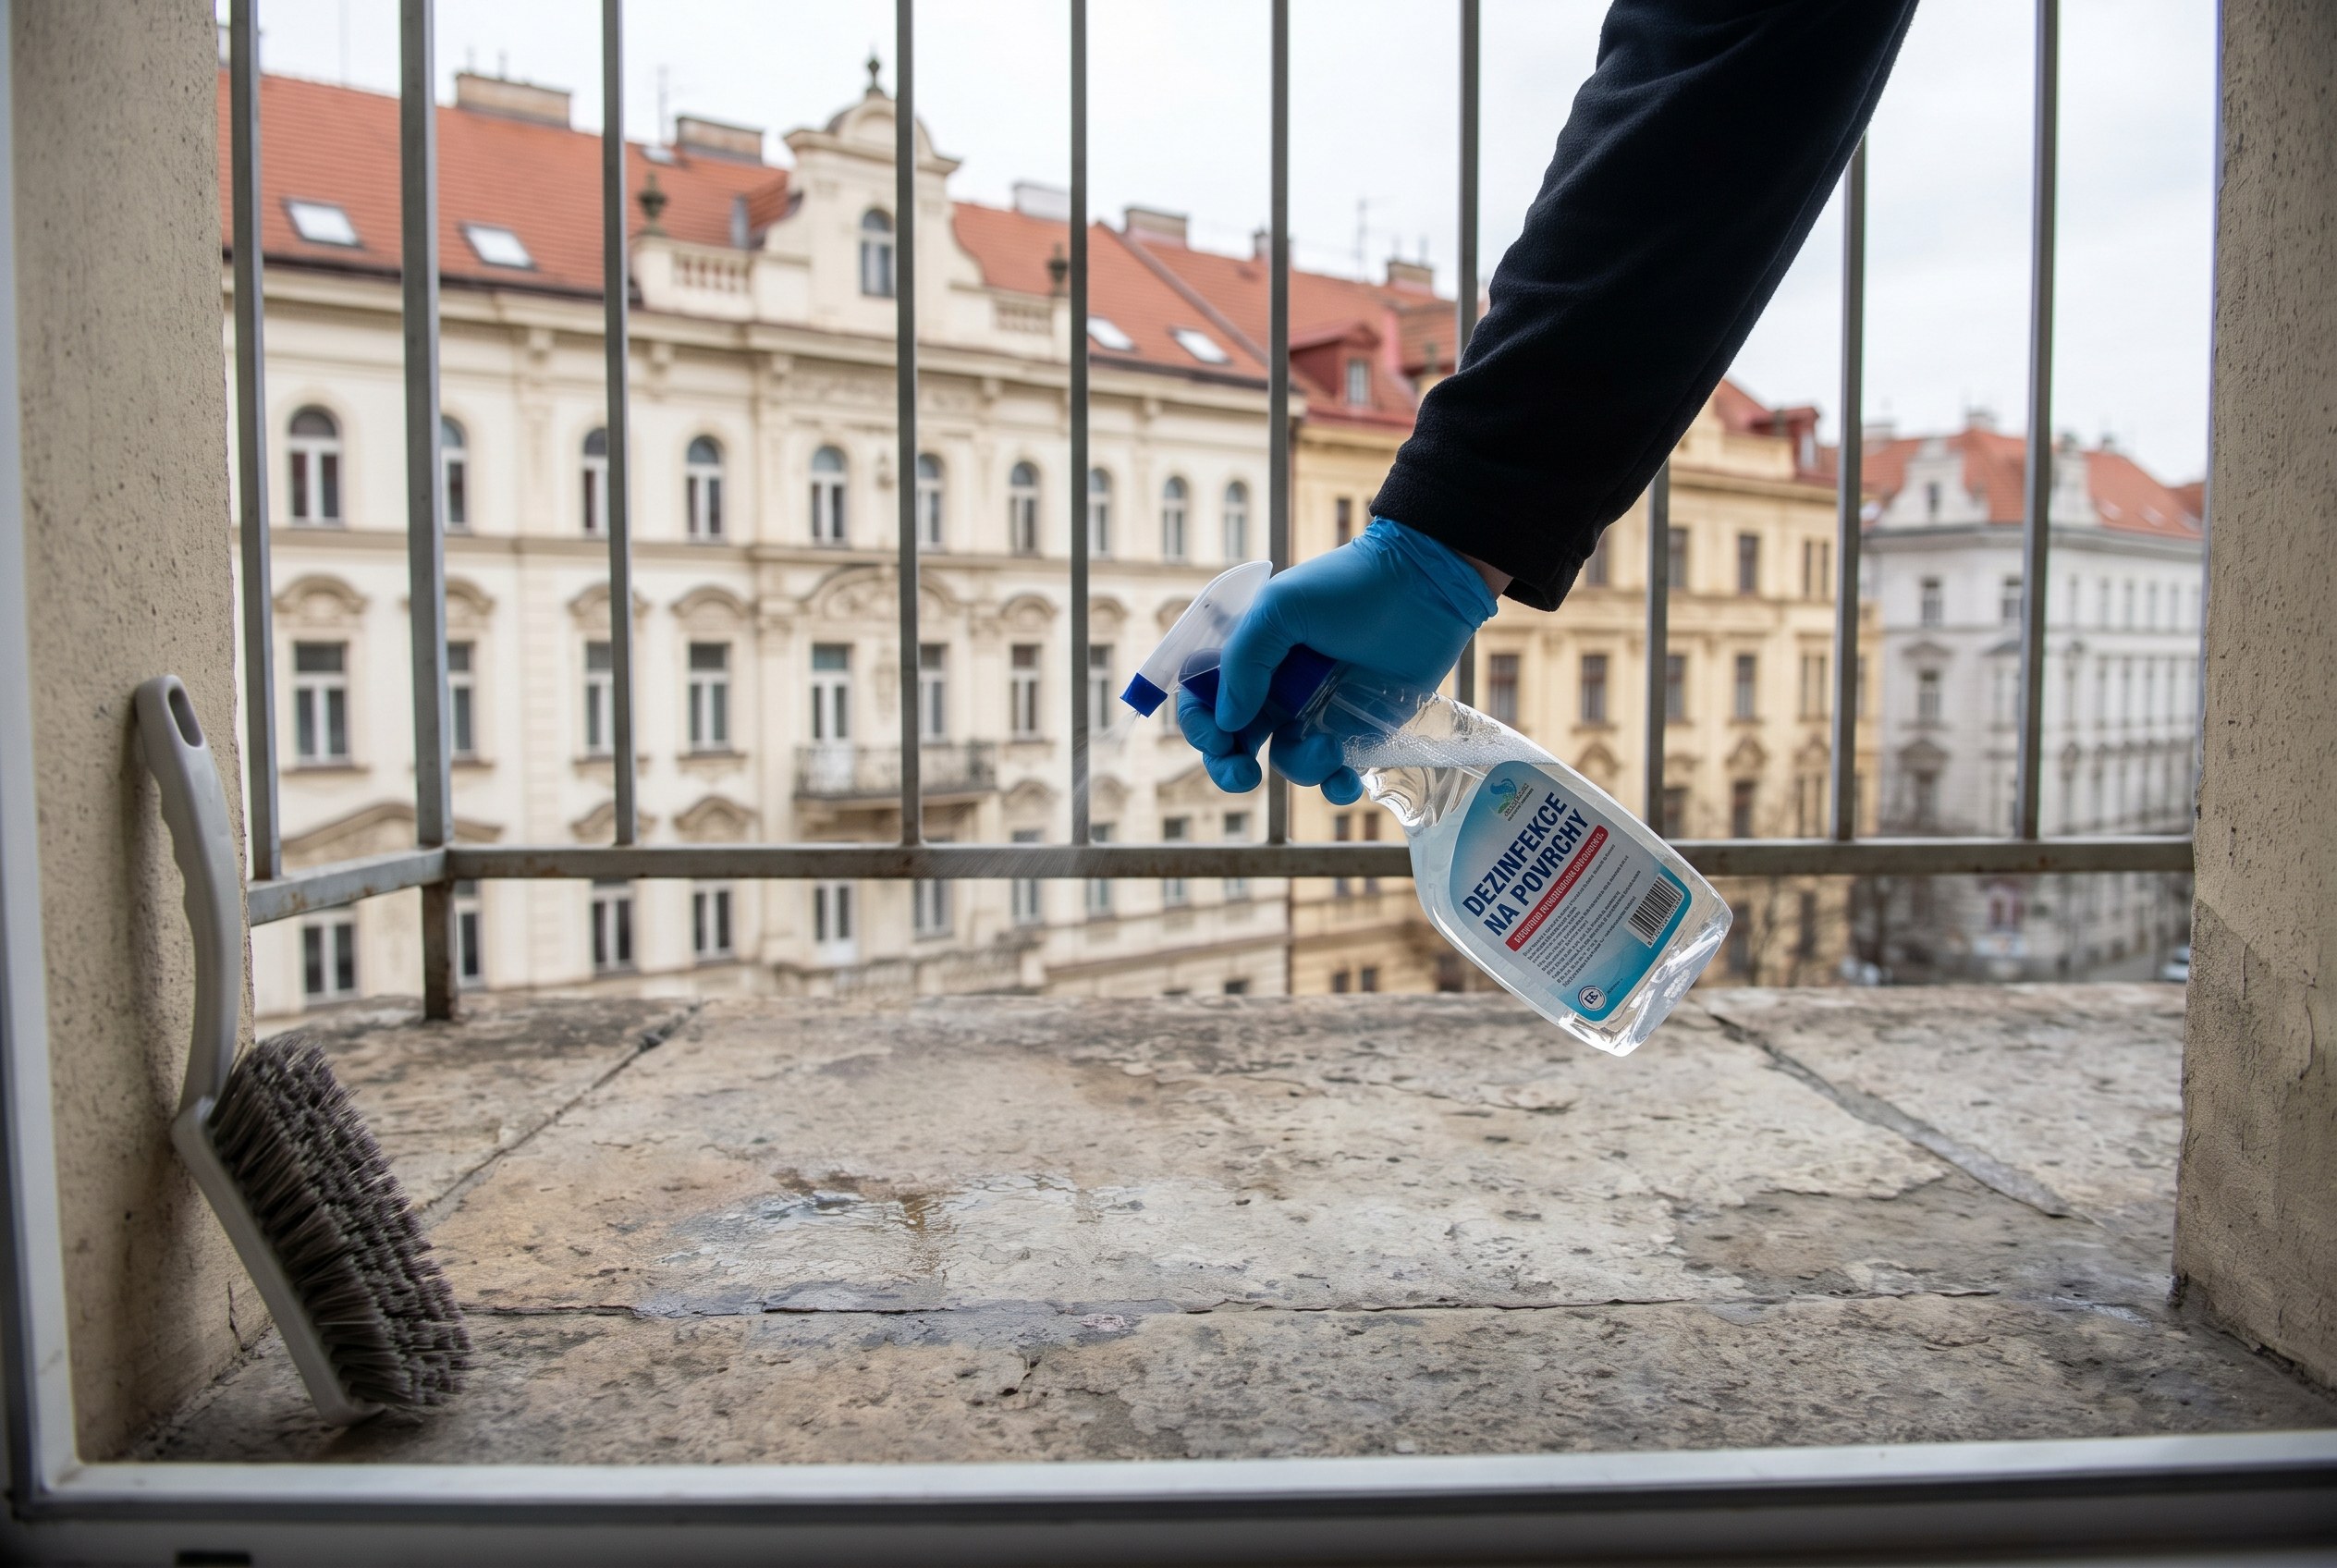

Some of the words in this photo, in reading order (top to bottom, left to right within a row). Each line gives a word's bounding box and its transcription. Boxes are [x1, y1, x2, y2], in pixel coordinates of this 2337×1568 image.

[1462, 791, 1568, 918] DEZINFEKCE
[1483, 902, 1521, 937] NA
[1510, 808, 1588, 906] POVRCHY
